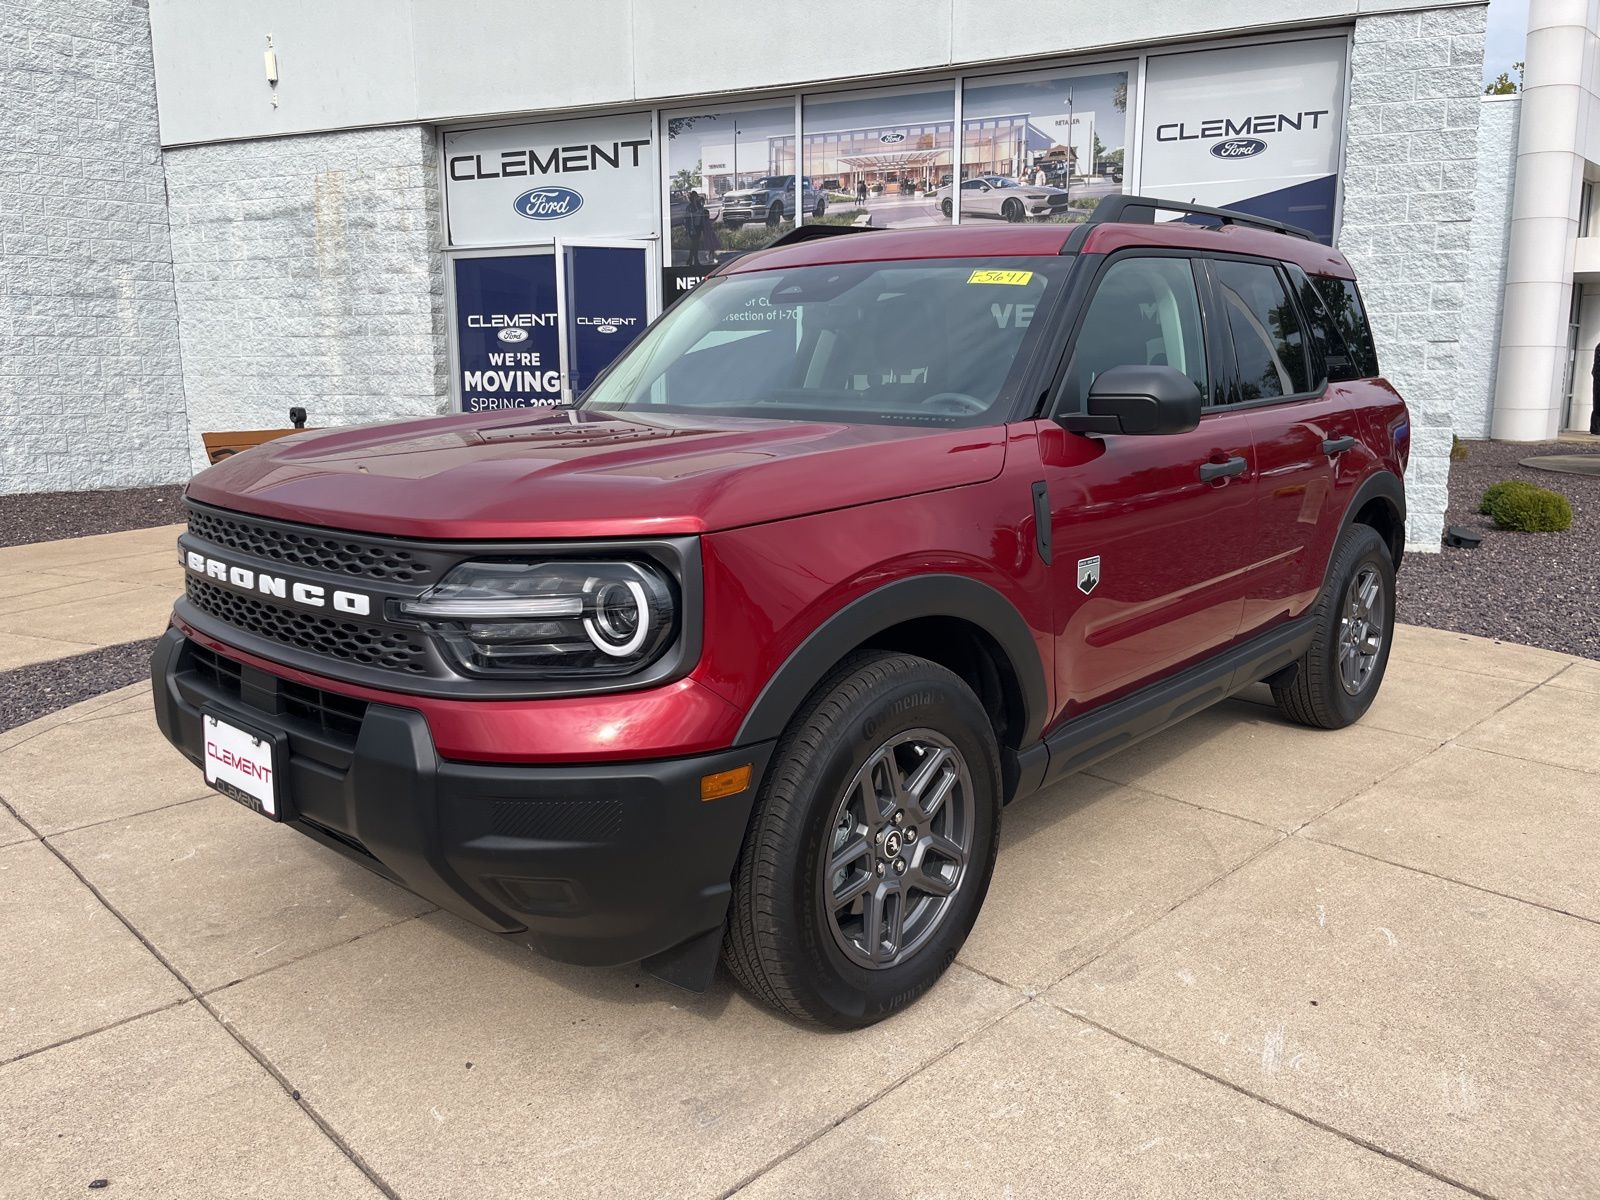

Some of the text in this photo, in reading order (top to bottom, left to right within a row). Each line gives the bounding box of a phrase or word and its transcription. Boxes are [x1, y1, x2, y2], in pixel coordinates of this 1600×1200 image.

[1156, 110, 1328, 142] CLEMENT
[1221, 141, 1255, 156] Ford
[450, 139, 650, 182] CLEMENT
[526, 191, 570, 215] Ford
[676, 277, 705, 290] NE
[467, 313, 558, 328] CLEMENT
[577, 317, 637, 326] CLEMENT
[766, 309, 777, 320] of
[503, 330, 523, 340] Ford
[488, 352, 541, 366] WE'RE
[464, 370, 561, 393] MOVING
[470, 397, 525, 411] SPRING
[187, 551, 370, 616] BRONCO
[207, 741, 272, 784] CLEMENT
[216, 779, 261, 812] CLEMENT
